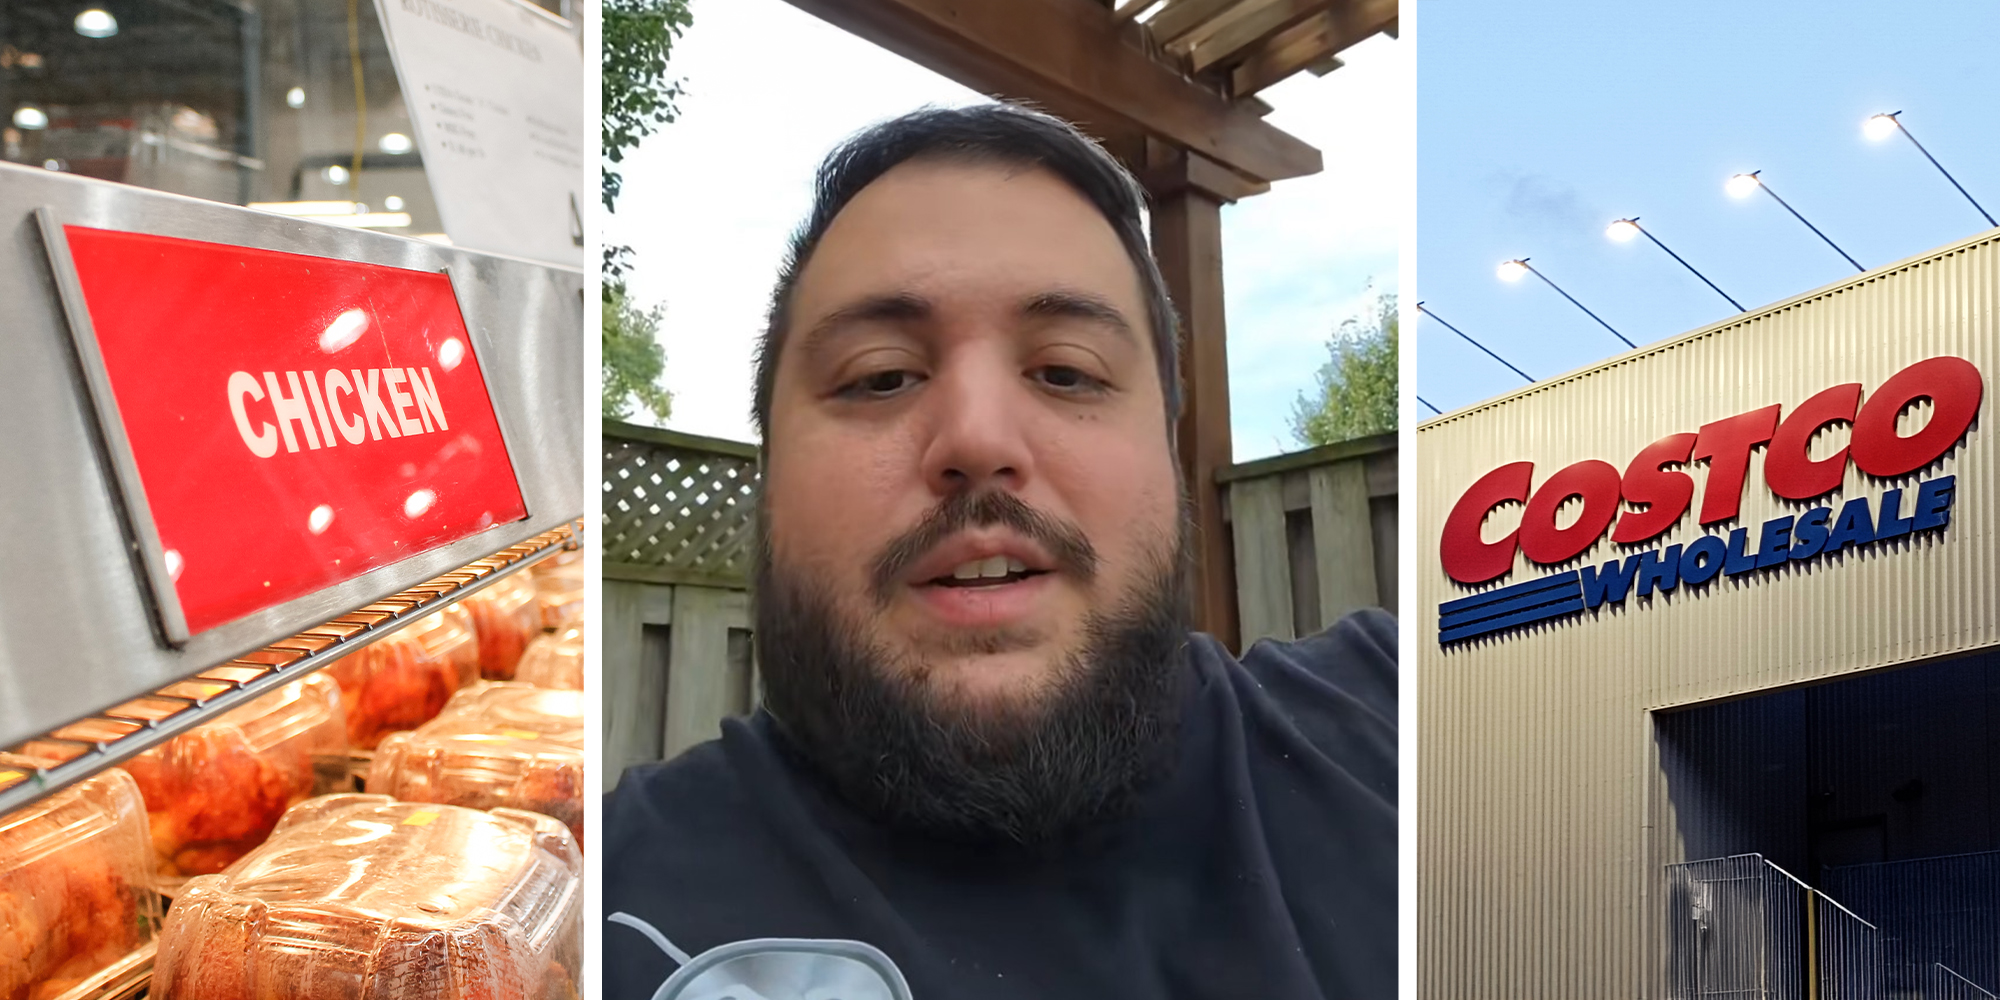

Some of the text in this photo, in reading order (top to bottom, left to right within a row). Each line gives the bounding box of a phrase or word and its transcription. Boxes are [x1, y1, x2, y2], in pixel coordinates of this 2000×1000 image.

[227, 367, 449, 458] CHICKEN
[1440, 355, 1982, 583] COSTCO
[1580, 474, 1955, 608] WHOLESALE
